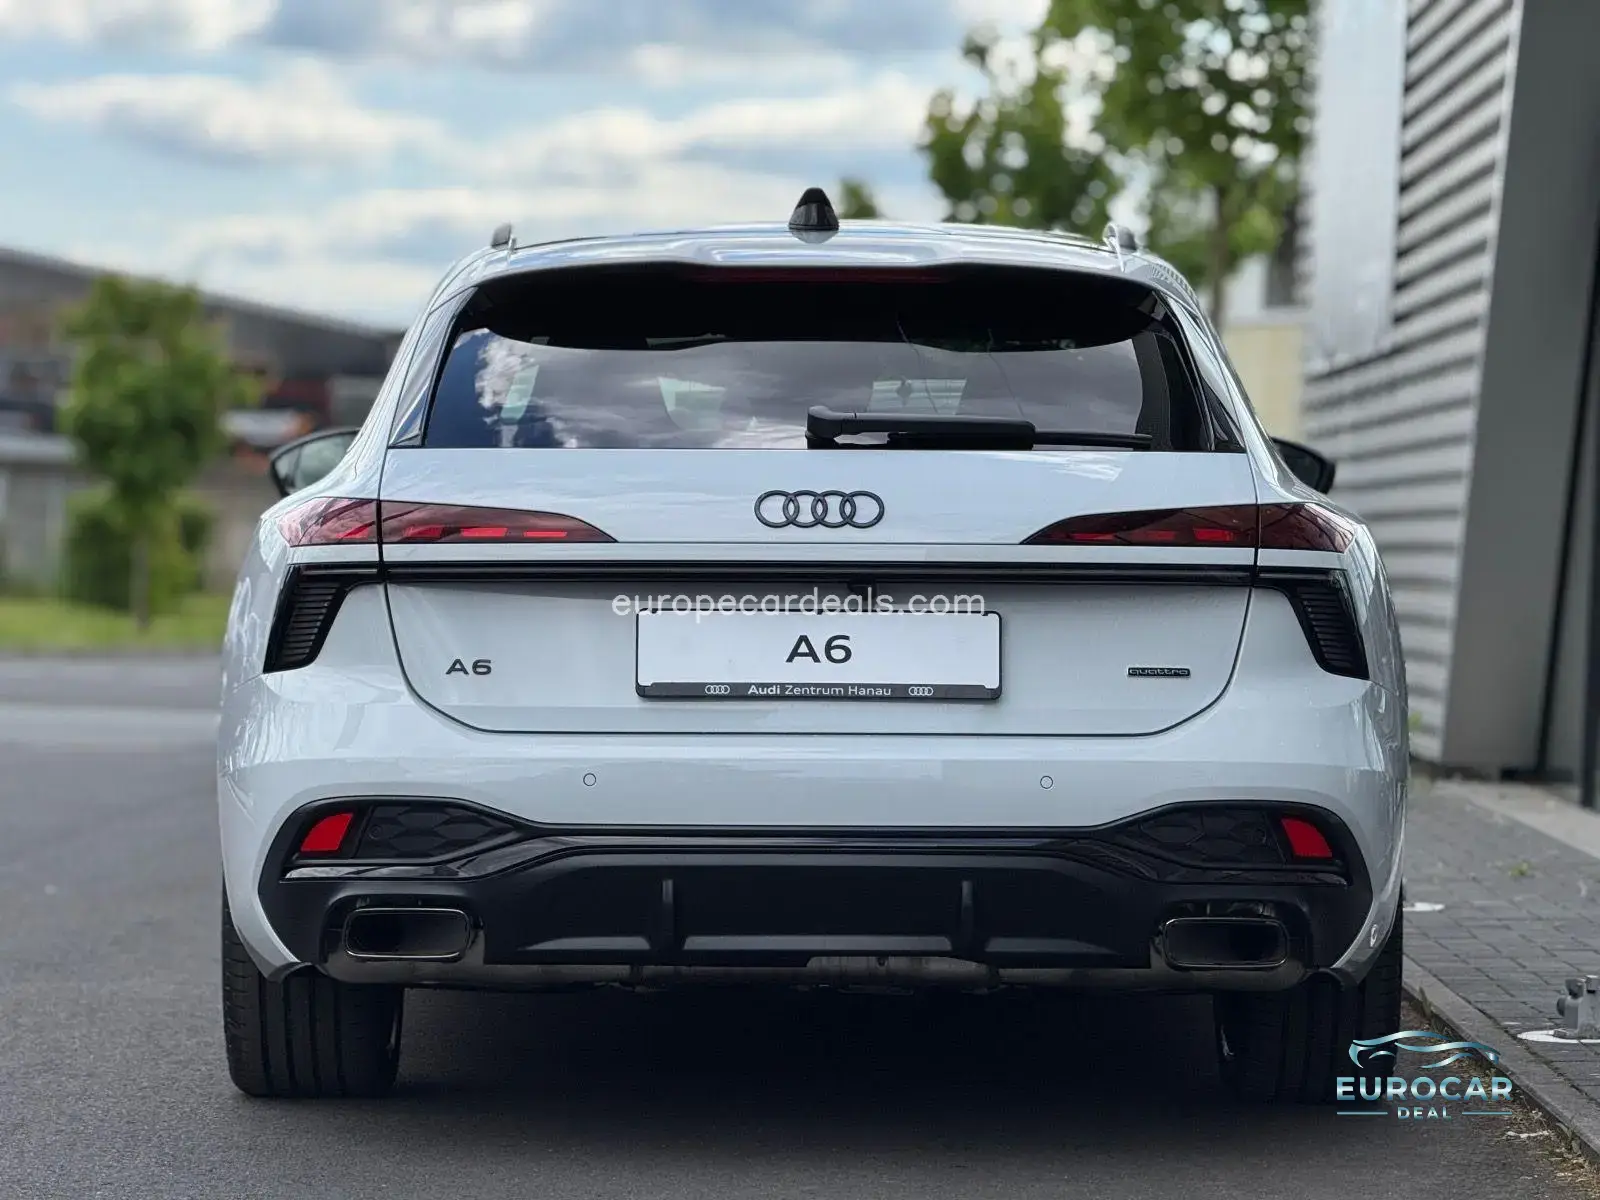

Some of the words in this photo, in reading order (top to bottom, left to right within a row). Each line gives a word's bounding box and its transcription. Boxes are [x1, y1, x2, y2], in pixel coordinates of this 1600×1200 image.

[785, 634, 853, 664] A6
[445, 658, 492, 676] A6
[1129, 668, 1189, 676] quattro
[748, 684, 781, 695] Audi
[784, 684, 844, 696] Zentrum
[847, 685, 892, 696] Hanau
